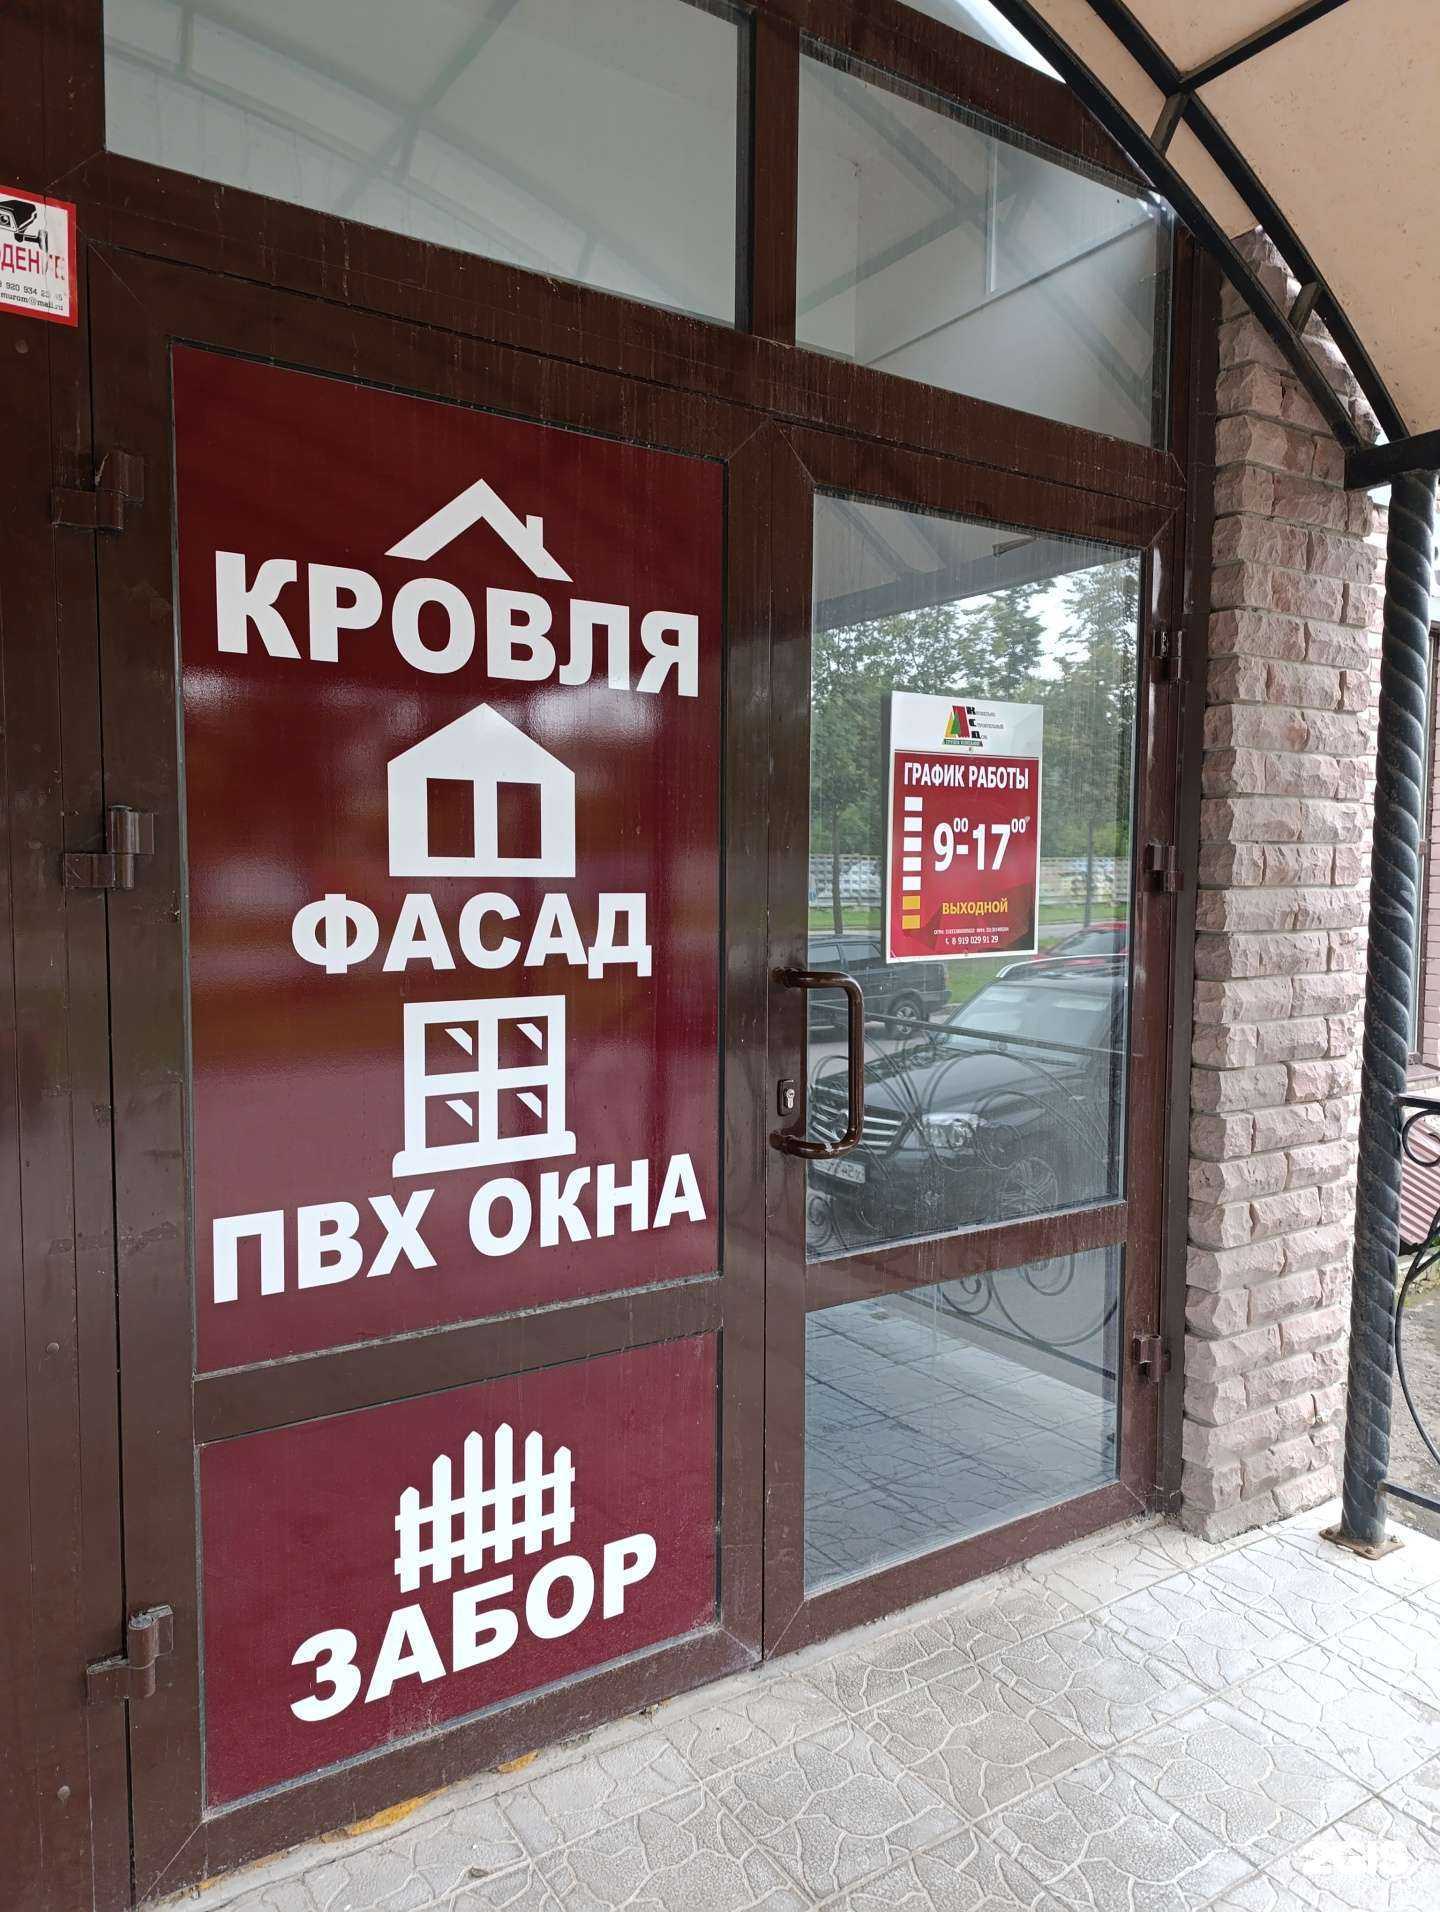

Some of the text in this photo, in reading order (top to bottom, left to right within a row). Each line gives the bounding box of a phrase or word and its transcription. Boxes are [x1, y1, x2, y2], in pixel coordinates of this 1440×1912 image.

[215, 550, 699, 698] КРОВЛЯ
[904, 762, 1029, 790] ГРАФИК РАБОТЫ
[291, 892, 652, 980] ФАСАД
[942, 898, 1008, 916] ВЫХОДНОЙ
[957, 937, 969, 945] 919
[212, 1153, 707, 1304] ПВХ ОКНА
[289, 1532, 658, 1723] ЗАБОР
